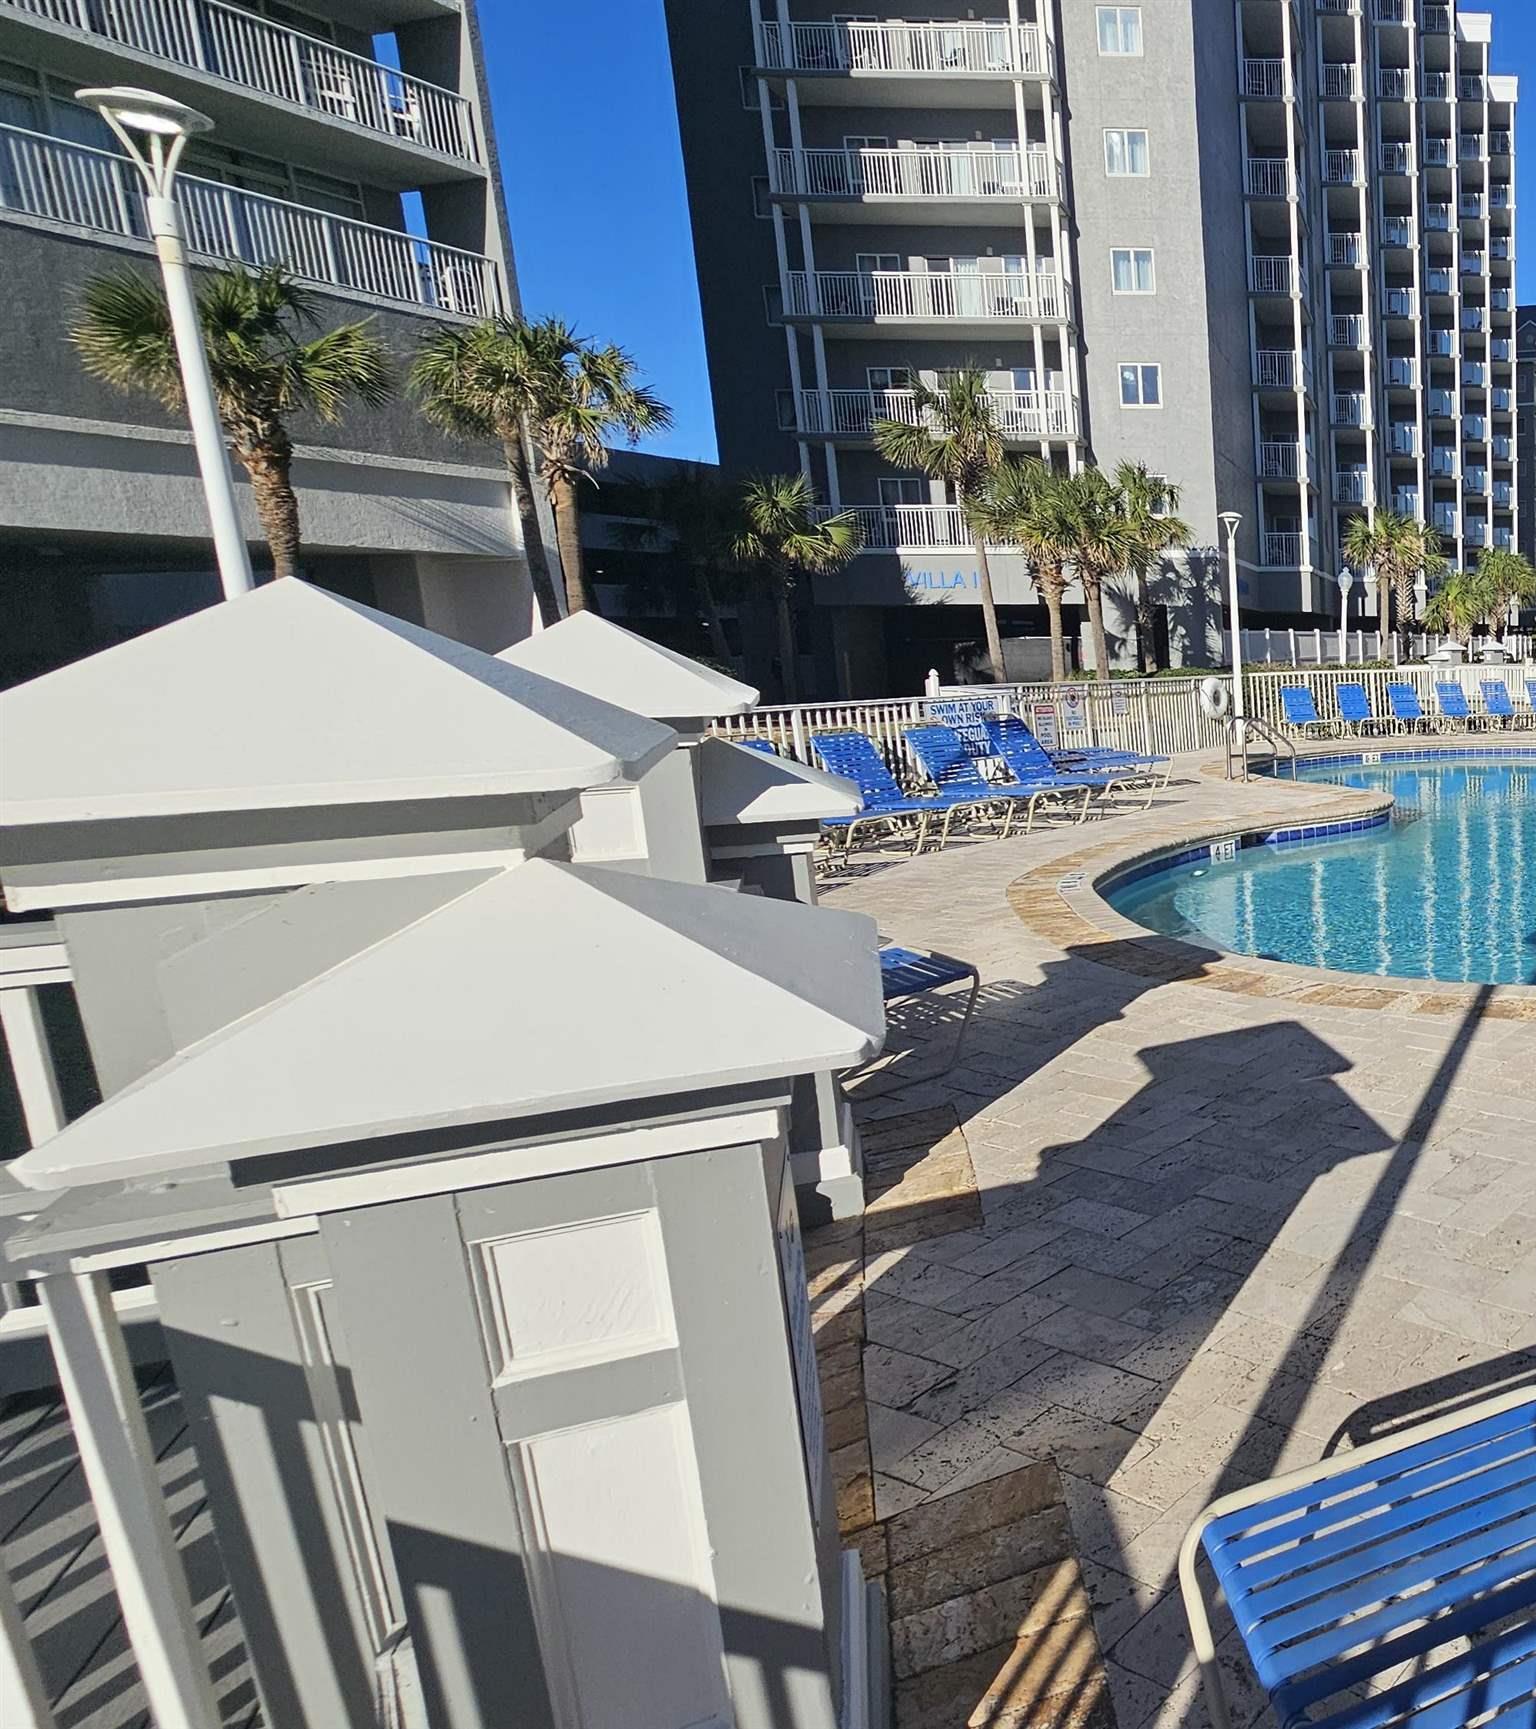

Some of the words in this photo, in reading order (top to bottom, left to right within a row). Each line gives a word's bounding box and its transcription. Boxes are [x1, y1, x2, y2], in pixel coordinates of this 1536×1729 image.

[904, 570, 967, 589] VILLA
[930, 703, 957, 715] SWIM
[958, 702, 970, 713] AT
[970, 700, 994, 711] YOUR
[942, 713, 966, 725] OWN
[966, 712, 986, 723] RISK
